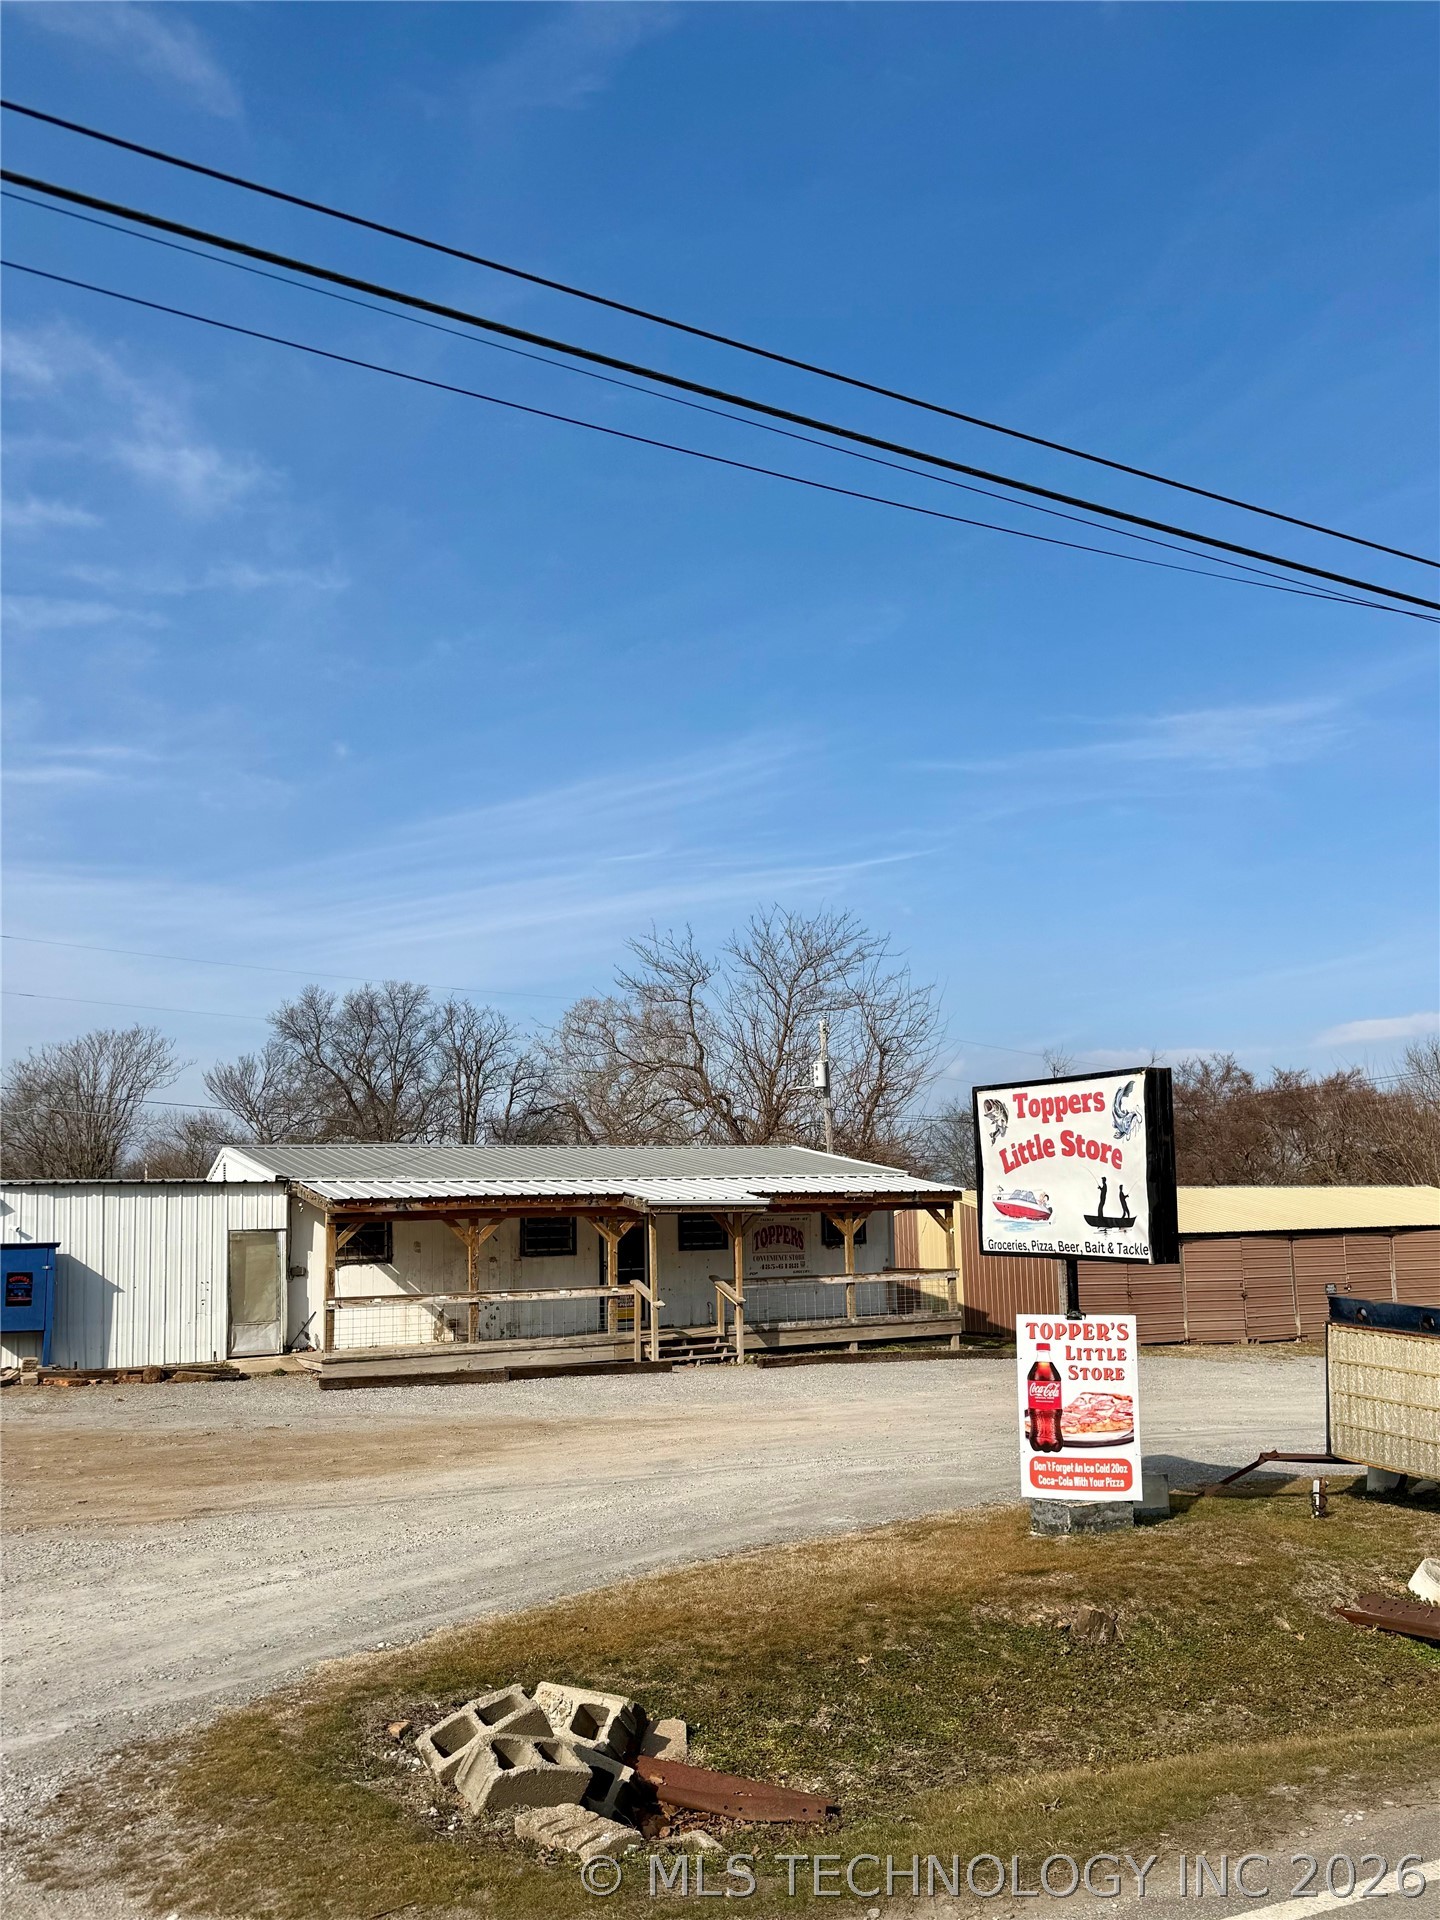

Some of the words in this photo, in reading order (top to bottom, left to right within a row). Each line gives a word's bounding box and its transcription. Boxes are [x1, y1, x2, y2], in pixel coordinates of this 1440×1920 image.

[1013, 1092, 1105, 1123] Toppers
[999, 1134, 1056, 1175] Little
[1060, 1130, 1123, 1170] Store
[754, 1225, 804, 1251] TOPPERS
[988, 1239, 1030, 1252] Groceries,
[1031, 1240, 1056, 1253] Pizza,
[1058, 1241, 1083, 1255] Beer,
[1085, 1242, 1105, 1254] Bait
[1107, 1242, 1114, 1254] &
[1117, 1242, 1149, 1255] Tackle
[752, 1254, 789, 1262] CONVENIENCE
[1025, 1322, 1129, 1342] TOPPER'S
[1065, 1345, 1127, 1361] LITTLE
[1068, 1365, 1125, 1381] STORE
[1030, 1382, 1060, 1397] Coca-Cola
[1033, 1461, 1051, 1471] Don't
[1051, 1462, 1074, 1475] Forget
[1075, 1463, 1083, 1473] An
[1083, 1463, 1094, 1473] Ice
[1095, 1463, 1110, 1473] Cold
[1111, 1463, 1128, 1473] 20oz
[1038, 1474, 1073, 1486] Coca-Cola
[1074, 1476, 1088, 1487] With
[1089, 1477, 1105, 1487] Your
[1105, 1477, 1125, 1488] Pizza
